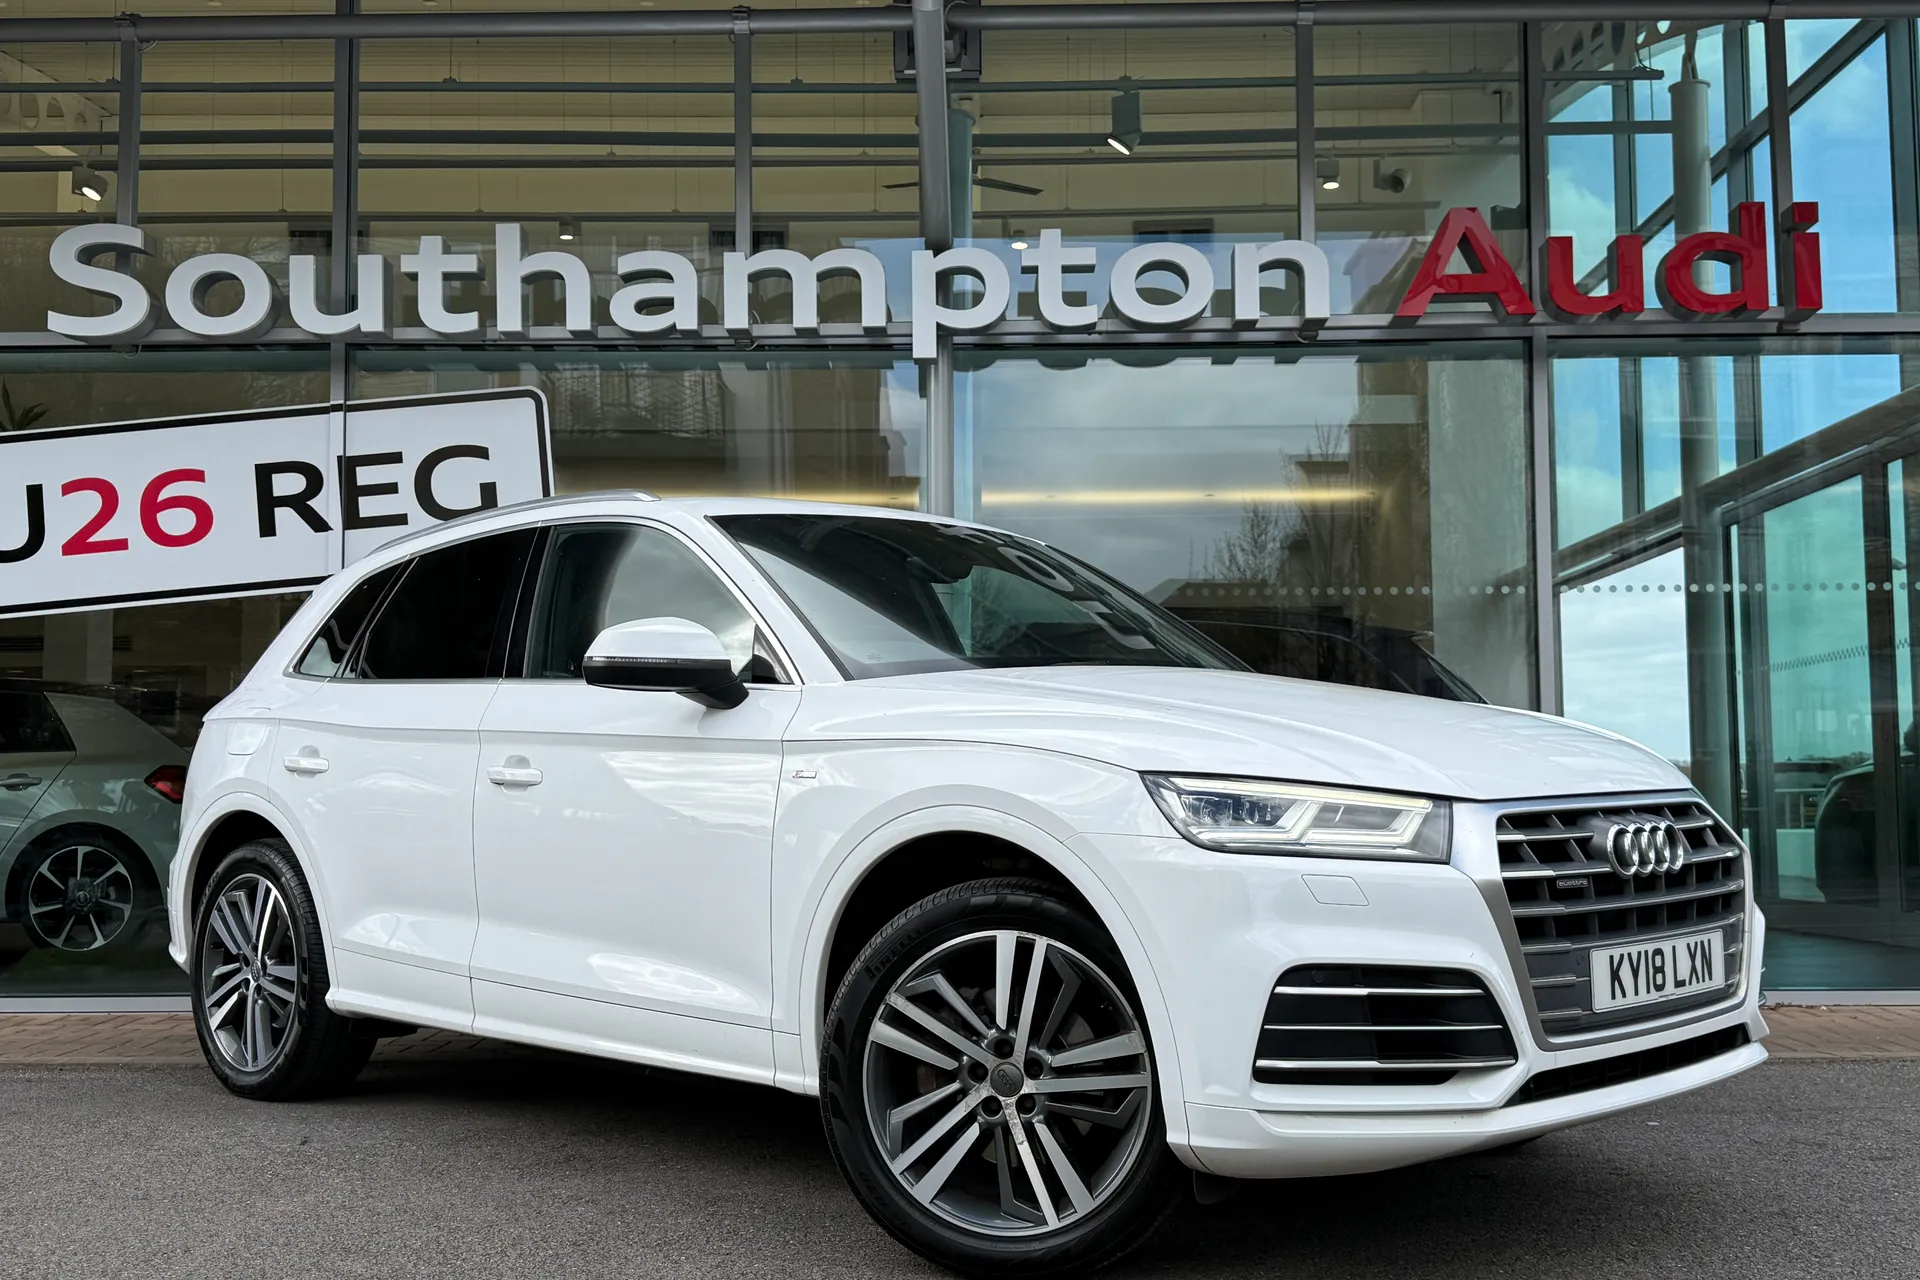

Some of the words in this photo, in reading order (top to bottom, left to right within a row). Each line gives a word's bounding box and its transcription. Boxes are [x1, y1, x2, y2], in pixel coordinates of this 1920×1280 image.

[47, 222, 1331, 359] Southampton
[1395, 201, 1824, 319] Audi
[254, 444, 499, 539] REG
[1608, 947, 1667, 1001] KY18
[1671, 938, 1713, 989] LXN
